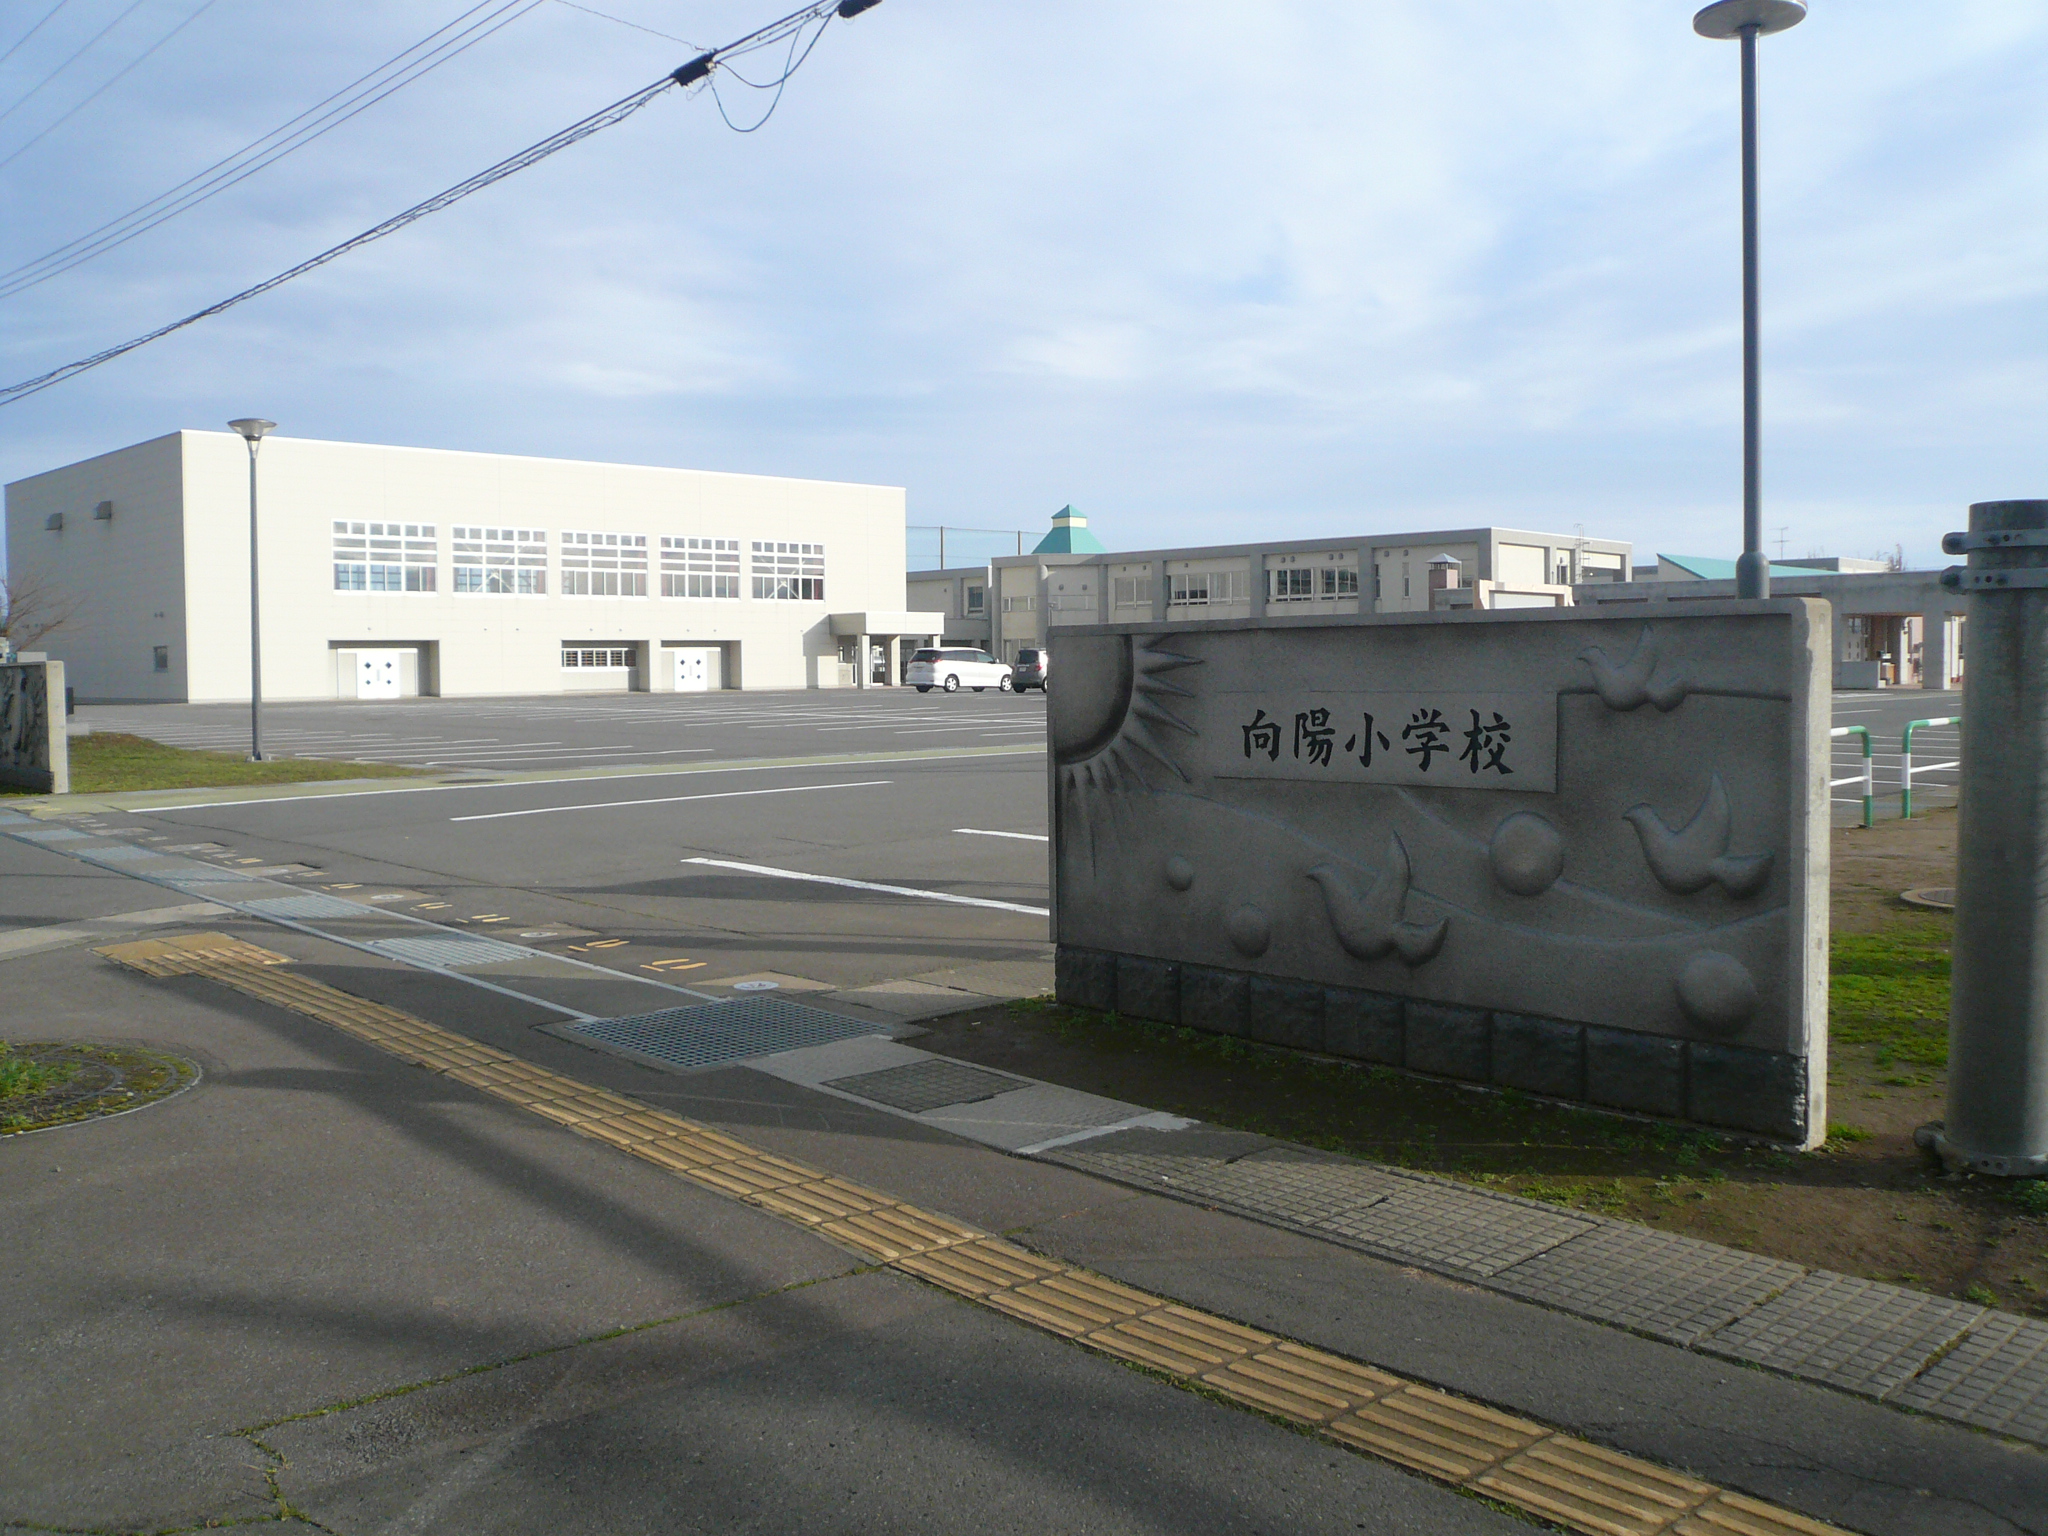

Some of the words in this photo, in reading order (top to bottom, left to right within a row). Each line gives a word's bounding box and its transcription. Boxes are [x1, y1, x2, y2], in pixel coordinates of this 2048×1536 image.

[1242, 707, 1514, 775] 向陽小学校
